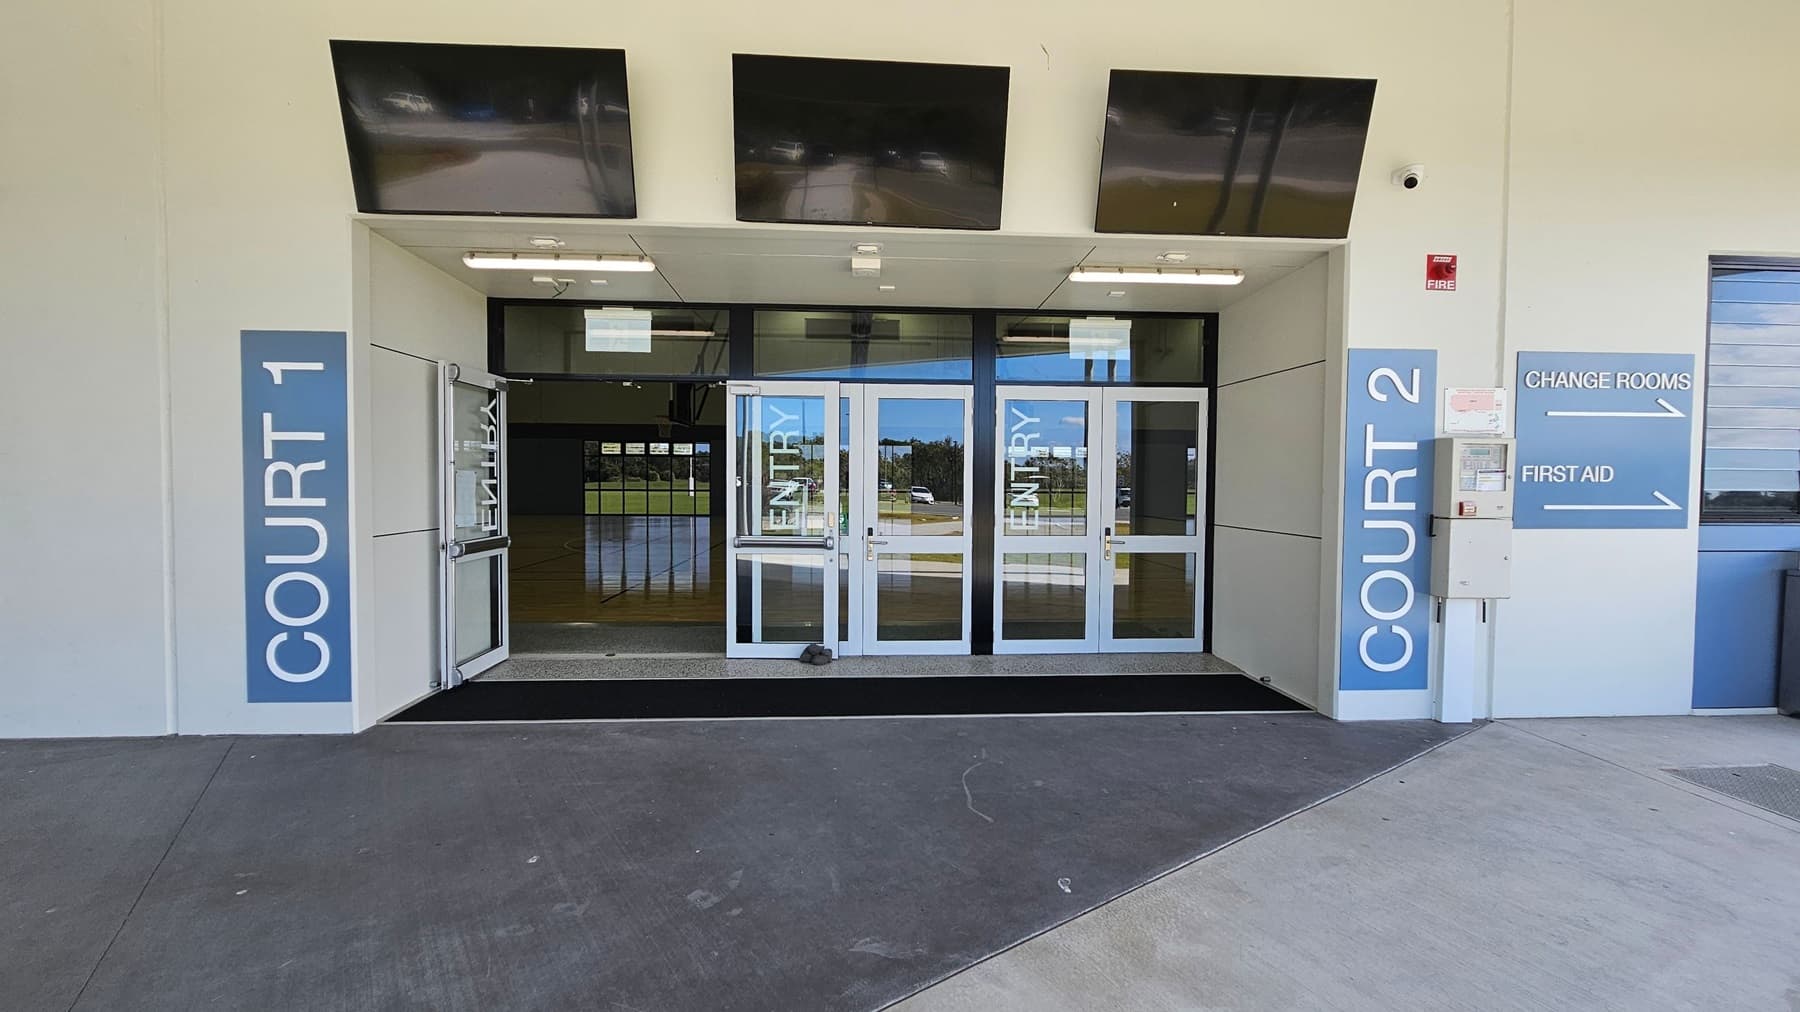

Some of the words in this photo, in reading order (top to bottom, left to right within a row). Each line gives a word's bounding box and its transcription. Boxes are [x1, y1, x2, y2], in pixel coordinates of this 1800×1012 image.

[1427, 279, 1455, 290] FIRE
[262, 360, 325, 385] 1
[1367, 366, 1420, 404] 2
[1525, 370, 1611, 389] CHANGE
[1616, 372, 1692, 390] ROOMS
[769, 404, 800, 530] ENTRY
[1010, 407, 1040, 531] ENTRY
[1521, 465, 1579, 483] FIRST
[1580, 465, 1615, 483] AID
[263, 412, 330, 683] COURT
[1359, 423, 1419, 673] COURT
